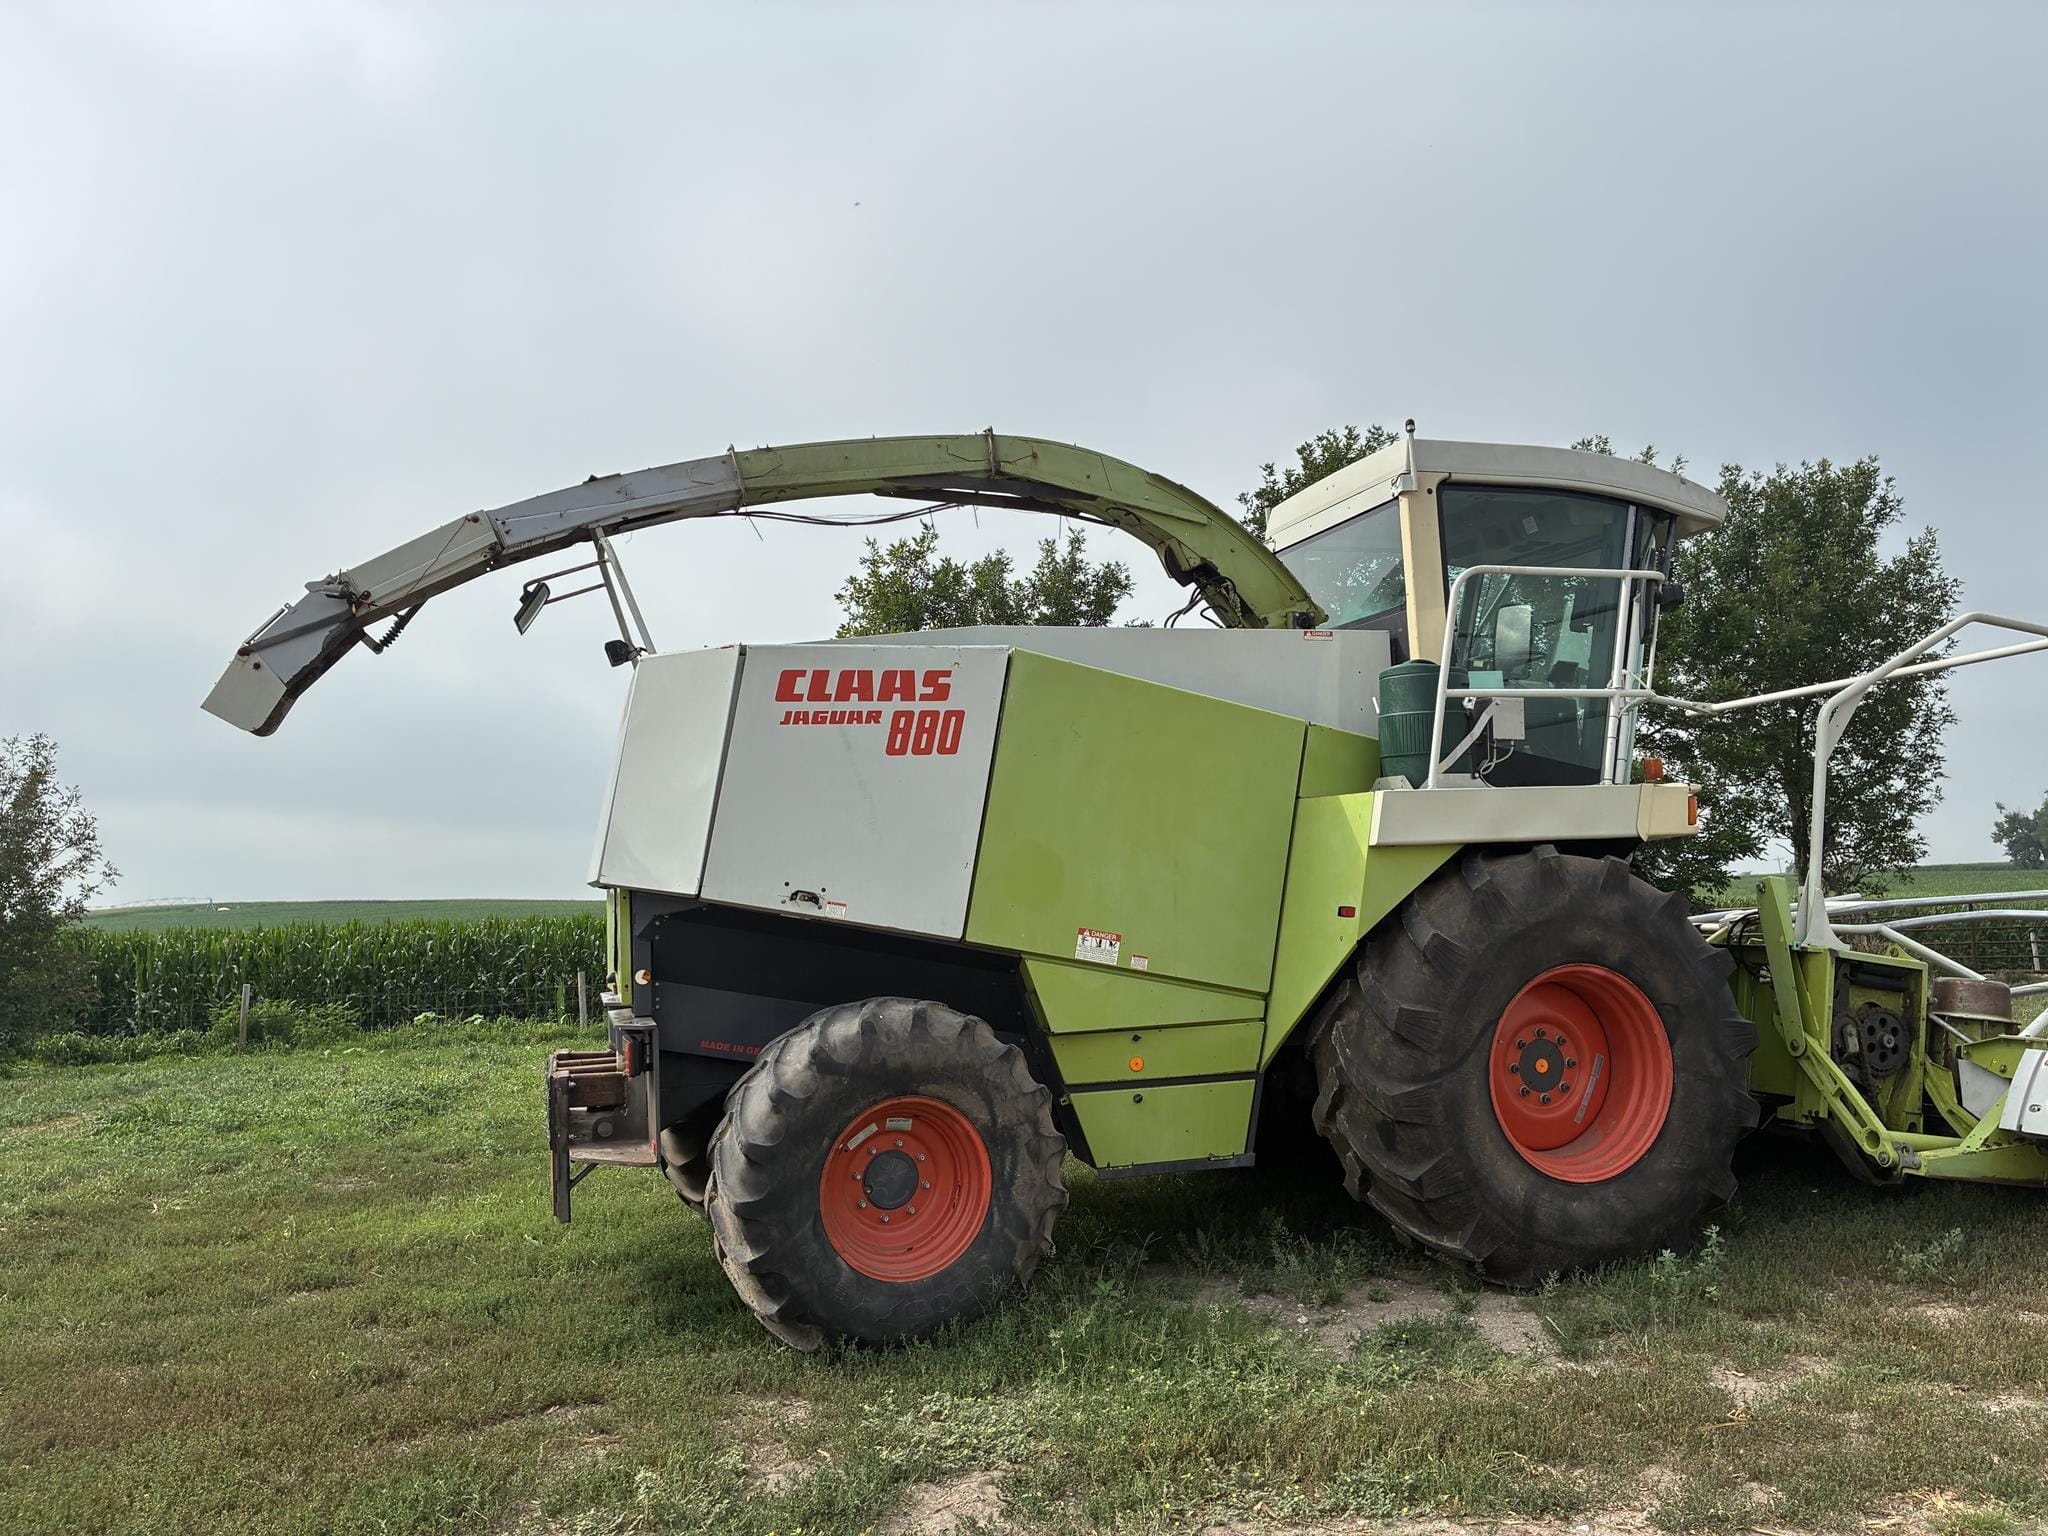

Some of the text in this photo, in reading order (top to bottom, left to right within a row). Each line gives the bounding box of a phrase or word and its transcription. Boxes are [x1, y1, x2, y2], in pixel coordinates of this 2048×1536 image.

[774, 669, 953, 702] CLAAS
[779, 709, 966, 756] JAGUAR 880
[1091, 930, 1117, 940] DANGER
[700, 1040, 761, 1056] MADE IN GE
